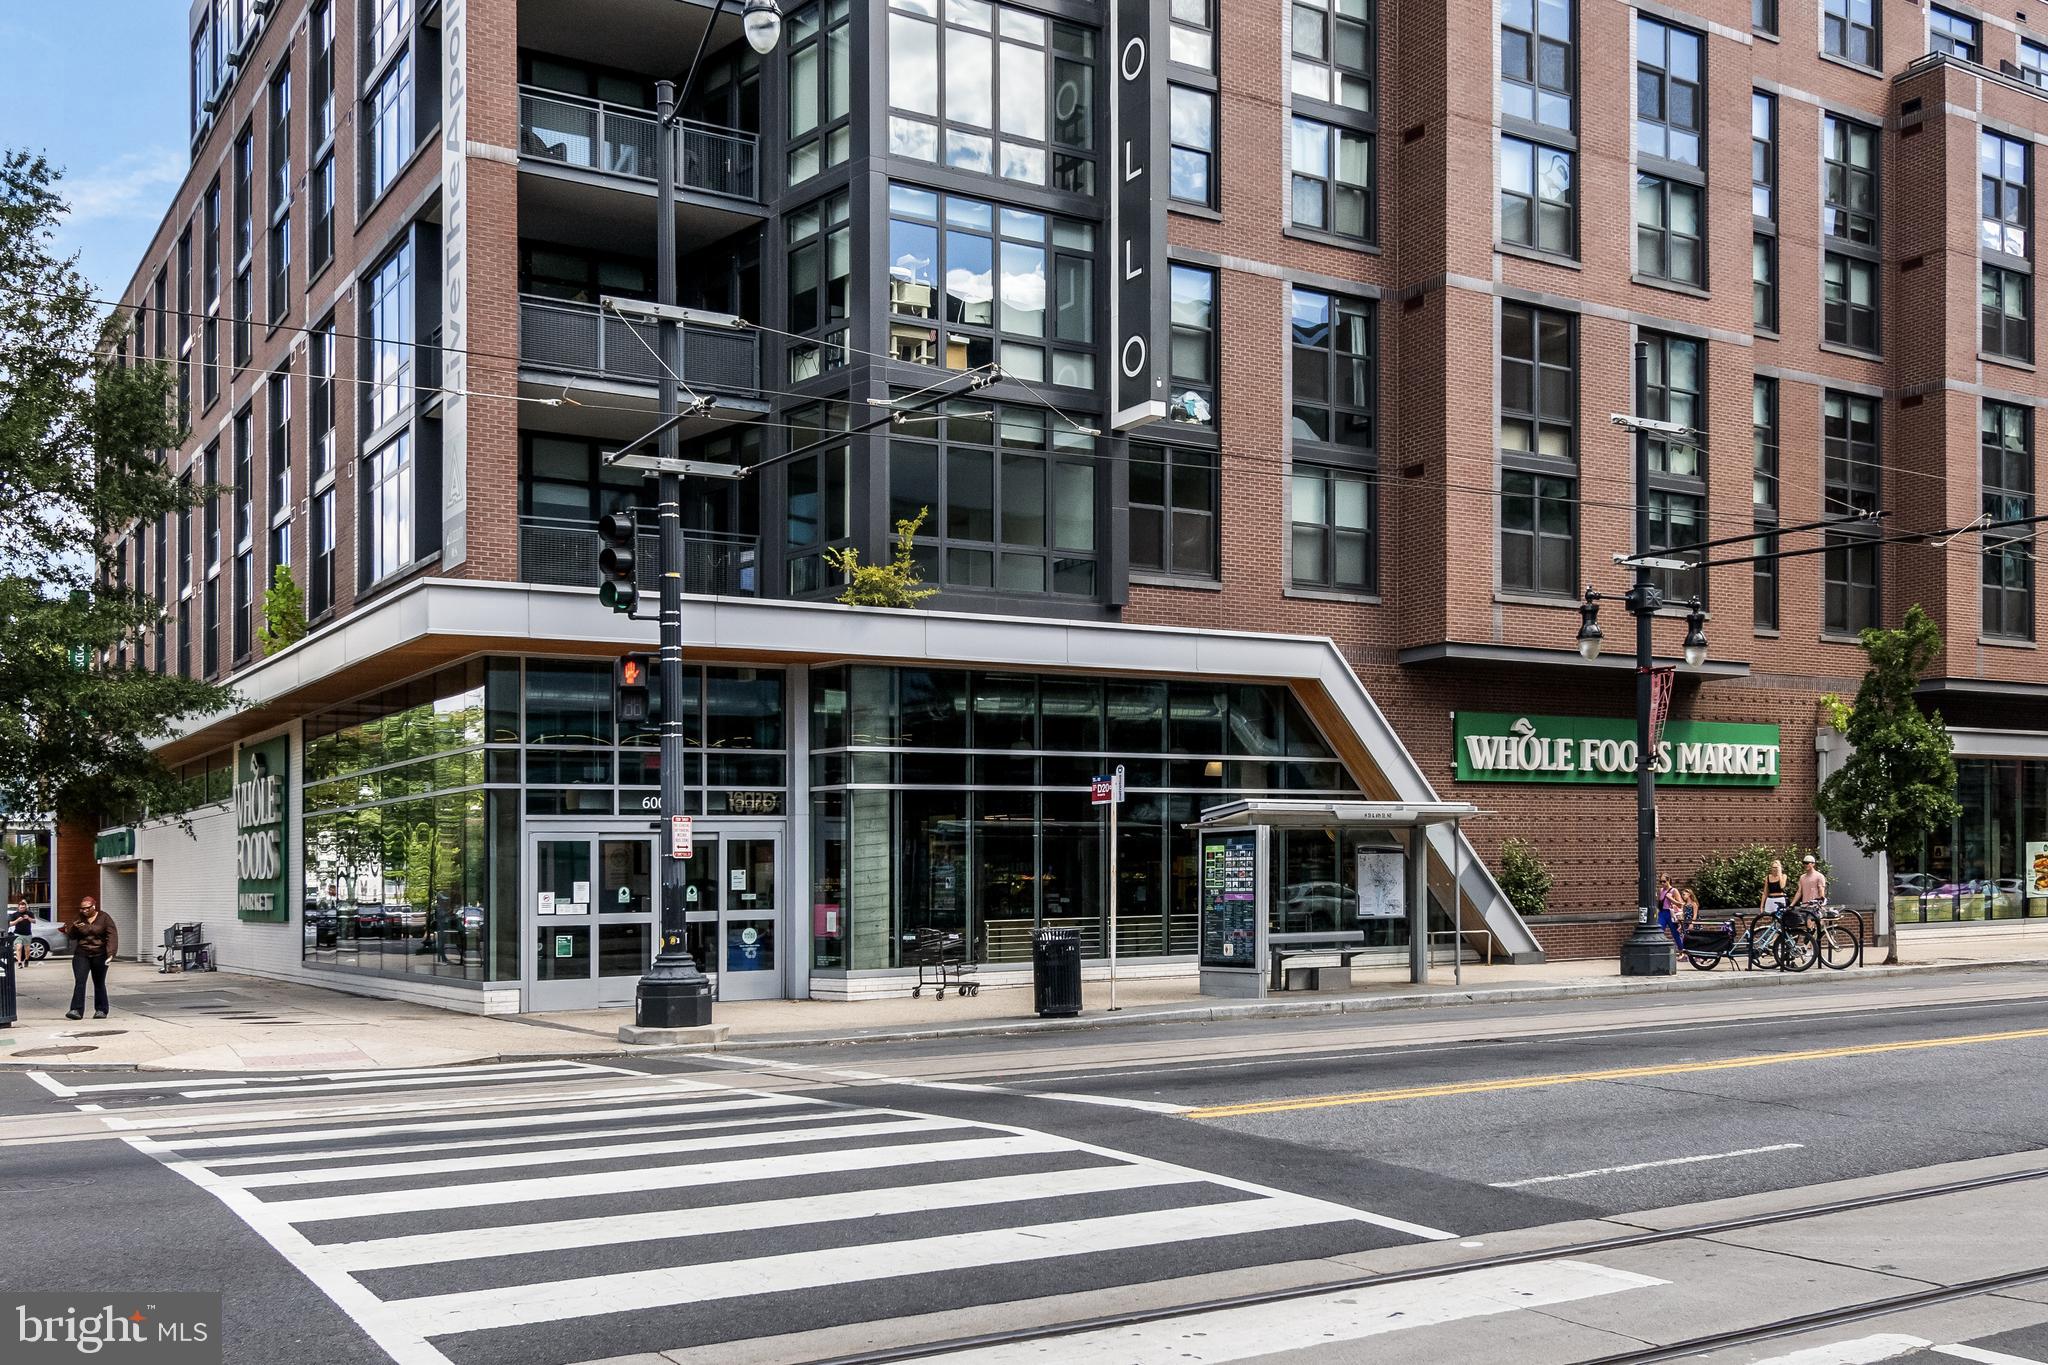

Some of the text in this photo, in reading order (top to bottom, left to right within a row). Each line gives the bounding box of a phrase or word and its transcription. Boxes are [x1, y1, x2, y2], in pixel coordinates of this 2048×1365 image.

[1464, 733, 1574, 771] WHOLE
[1677, 741, 1780, 775] MARKET
[233, 775, 281, 829] WHOLE
[1097, 783, 1110, 793] D20
[237, 829, 280, 880] FOODS
[239, 893, 275, 911] MARKET
